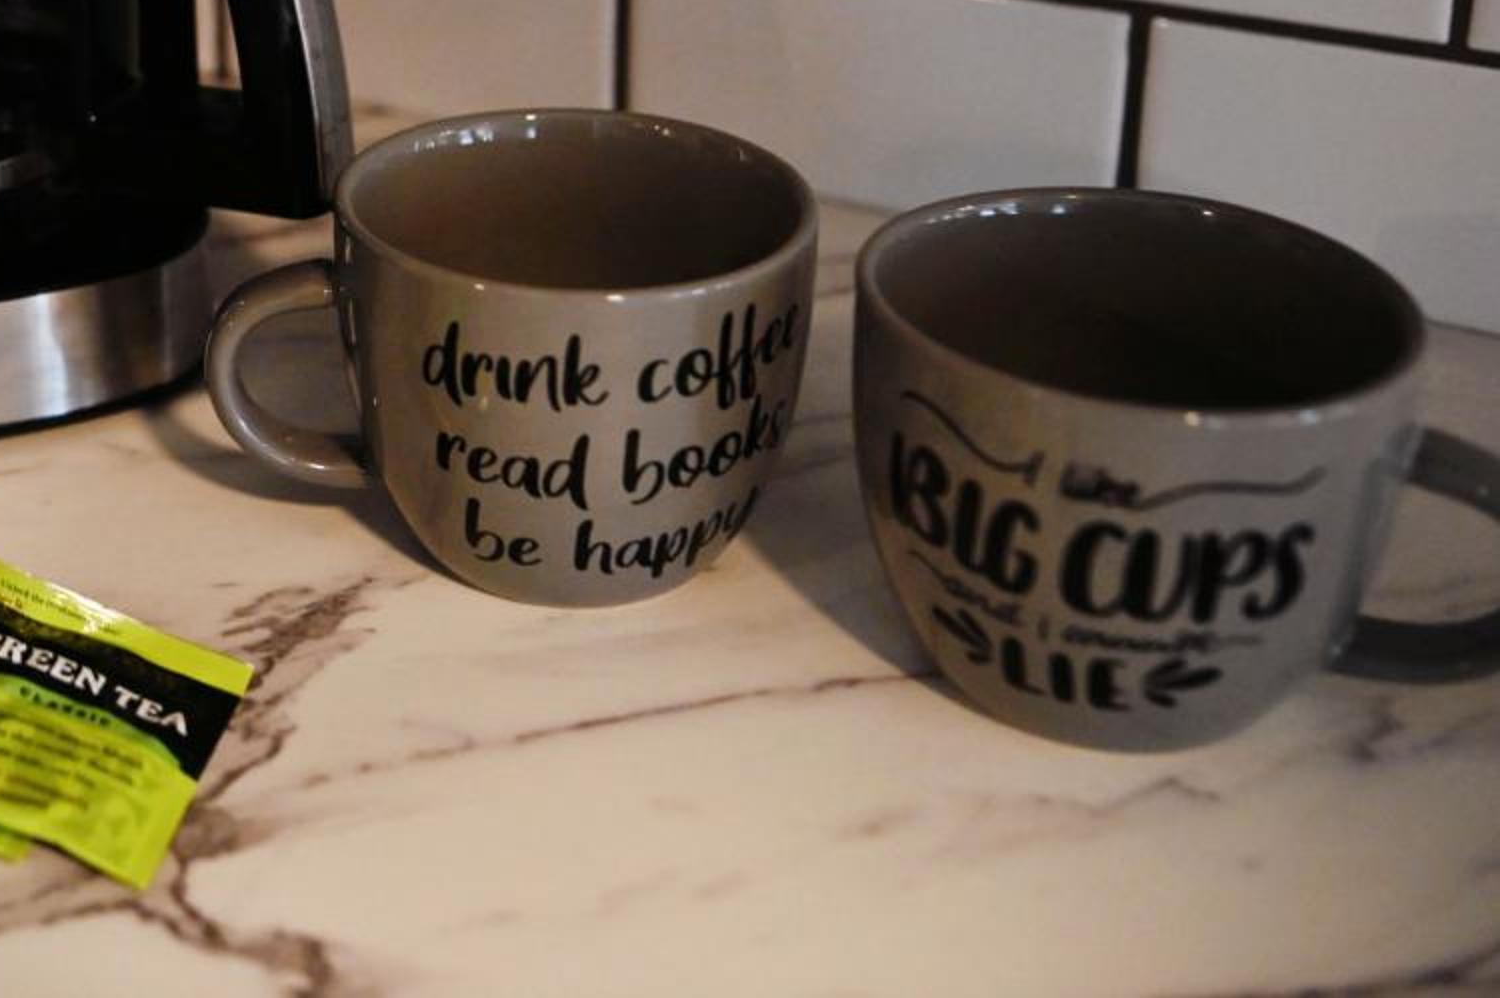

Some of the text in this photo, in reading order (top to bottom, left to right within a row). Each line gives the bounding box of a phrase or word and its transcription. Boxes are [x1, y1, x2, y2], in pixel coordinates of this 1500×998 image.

[421, 319, 609, 413] drink
[435, 392, 787, 511] read books
[463, 485, 759, 578] be happy
[890, 430, 1315, 626] BIG CUPS
[114, 684, 188, 737] TEA
